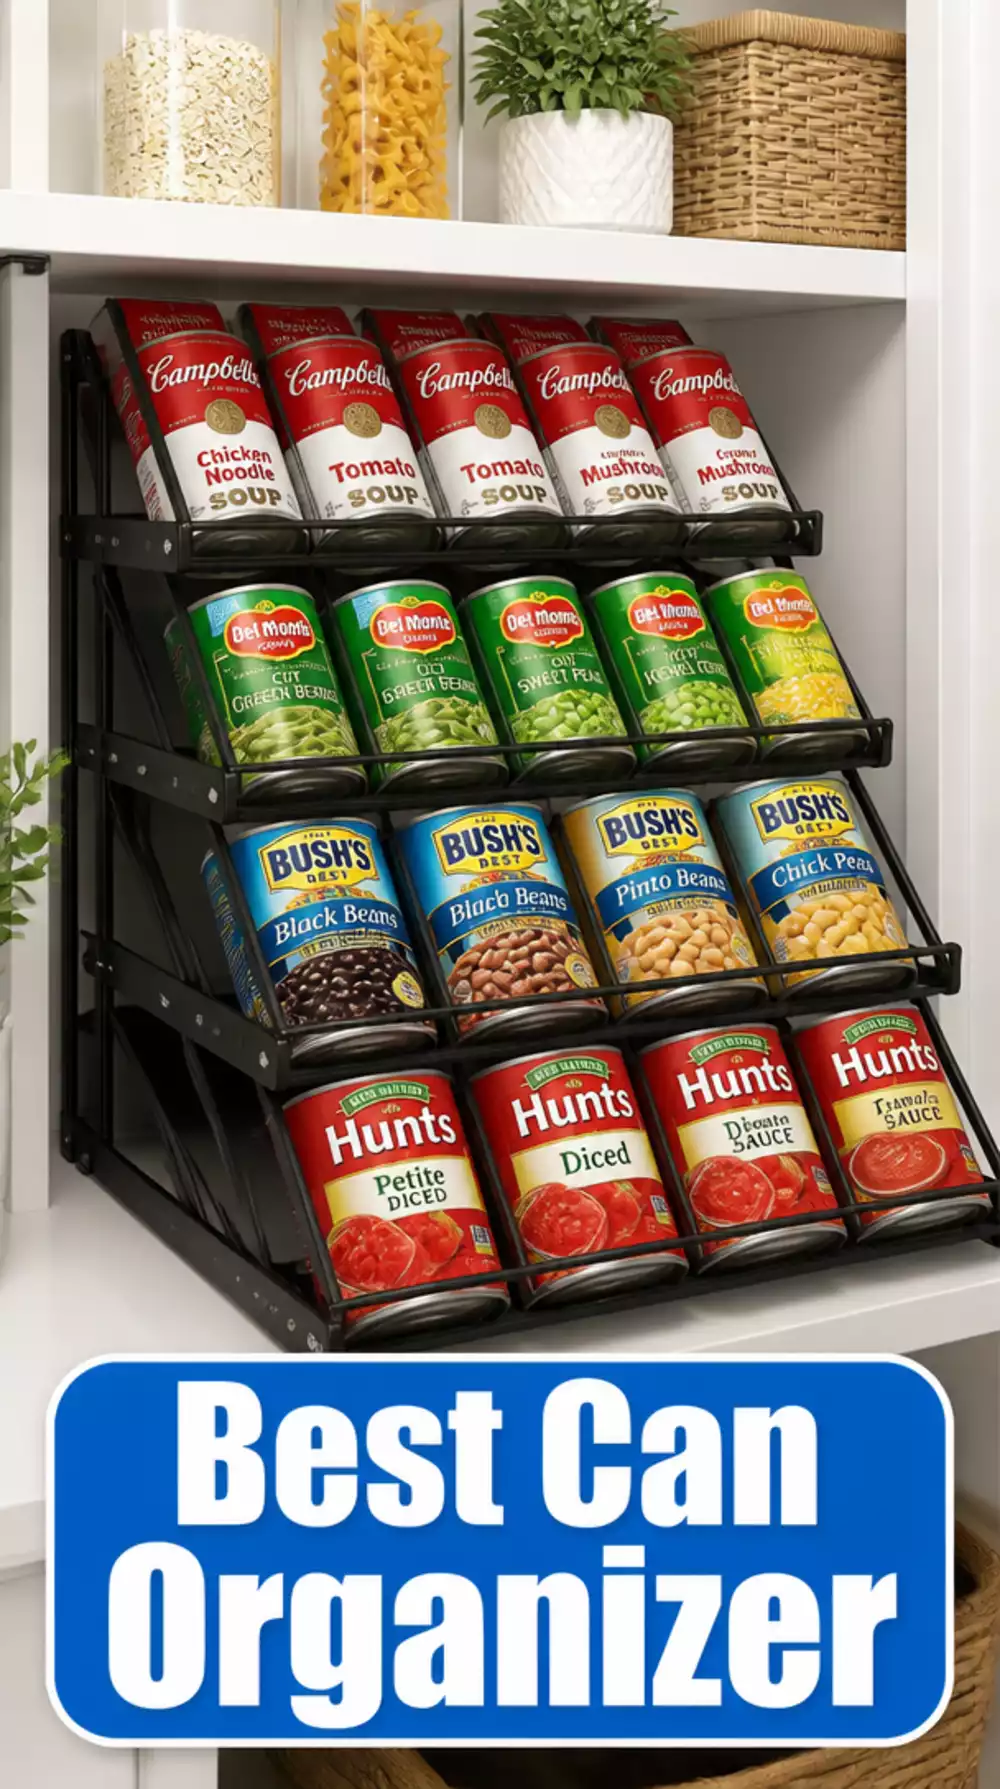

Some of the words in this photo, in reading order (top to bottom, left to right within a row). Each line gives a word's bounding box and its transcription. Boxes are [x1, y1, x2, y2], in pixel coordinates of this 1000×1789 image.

[197, 446, 273, 468] Chicken
[329, 457, 416, 483] Tomato
[204, 461, 276, 487] Noodle
[460, 458, 545, 484] Tomato
[209, 486, 282, 510] SOUP
[347, 485, 419, 508] SOUP
[481, 484, 547, 505] SOUP
[607, 483, 669, 504] SOUP
[722, 483, 779, 501] SOUP
[232, 621, 261, 643] Del
[377, 616, 404, 637] Del
[757, 791, 851, 834] BUSH'S
[603, 807, 698, 849] BUSH'S
[441, 820, 541, 866] BUSH'S
[267, 839, 371, 882] BUSH'S
[772, 852, 833, 888] Chick
[515, 887, 568, 911] Beans
[615, 874, 672, 907] Pinto
[275, 906, 338, 945] Black
[343, 903, 398, 928] Beans
[831, 1037, 939, 1088] Hunts
[677, 1056, 792, 1111] Hunts
[511, 1082, 634, 1139] Hunts
[884, 1106, 943, 1130] SAUCE
[324, 1105, 457, 1166] Hunts
[559, 1140, 632, 1176] Diced
[373, 1166, 445, 1196] Petite
[387, 1187, 448, 1212] DICED
